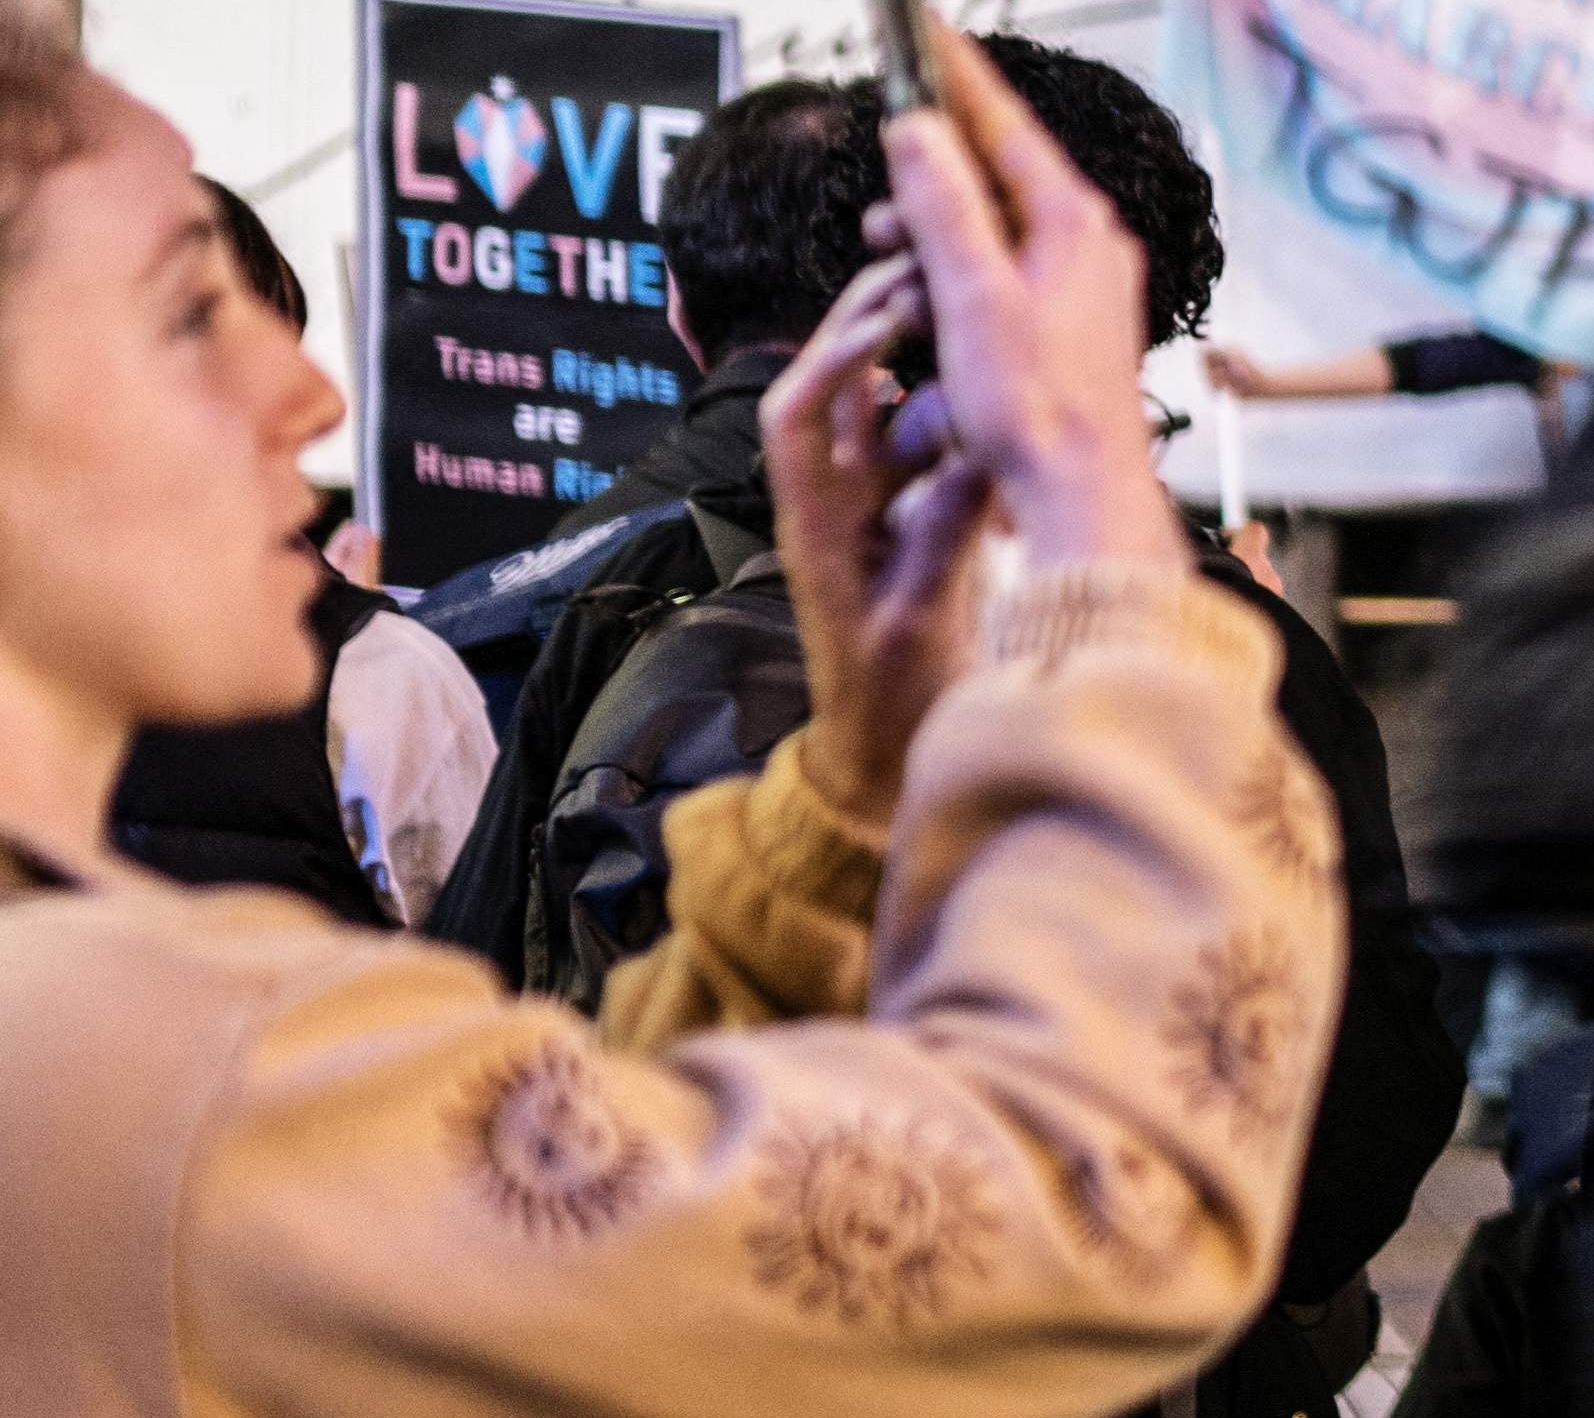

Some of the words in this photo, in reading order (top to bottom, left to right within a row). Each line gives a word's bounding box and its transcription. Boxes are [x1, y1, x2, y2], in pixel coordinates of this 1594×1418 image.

[394, 216, 667, 308] TOGETHE
[433, 335, 544, 390] Trans
[550, 347, 682, 408] Rights
[511, 402, 583, 445] are
[412, 440, 546, 498] Human
